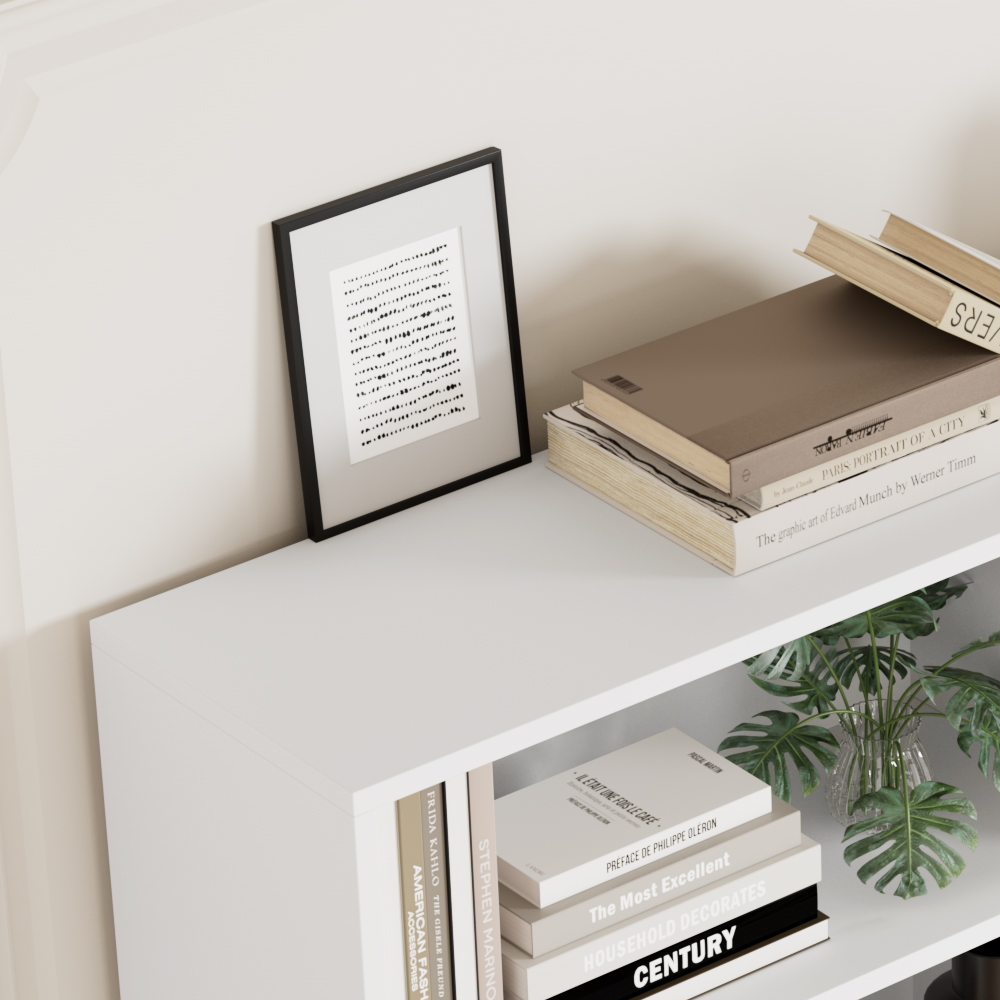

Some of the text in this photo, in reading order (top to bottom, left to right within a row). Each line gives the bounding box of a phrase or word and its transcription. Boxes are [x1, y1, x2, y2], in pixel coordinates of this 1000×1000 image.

[822, 416, 965, 481] PARIS: PORTRAIT OF A CITY
[756, 454, 977, 548] The graphic art of Edvard Munch by Werner Timm
[427, 790, 437, 834] FRIDA
[600, 789, 634, 809] UNE FOIS
[430, 837, 440, 887] KAHLO
[606, 818, 718, 873] PRÉFACE DE PHILIPPE OLÉRON
[412, 864, 428, 954] AMERICAN
[433, 895, 441, 916] THE
[478, 838, 497, 1000] STEPHEN MARINO
[588, 851, 731, 923] The Most Excellent
[407, 911, 419, 992] ACCESSORIES
[434, 918, 442, 955] GISELE
[584, 880, 767, 973] HOUSEHOLD DECORATES
[632, 925, 737, 989] CENTURY
[436, 957, 445, 998] FREUND
